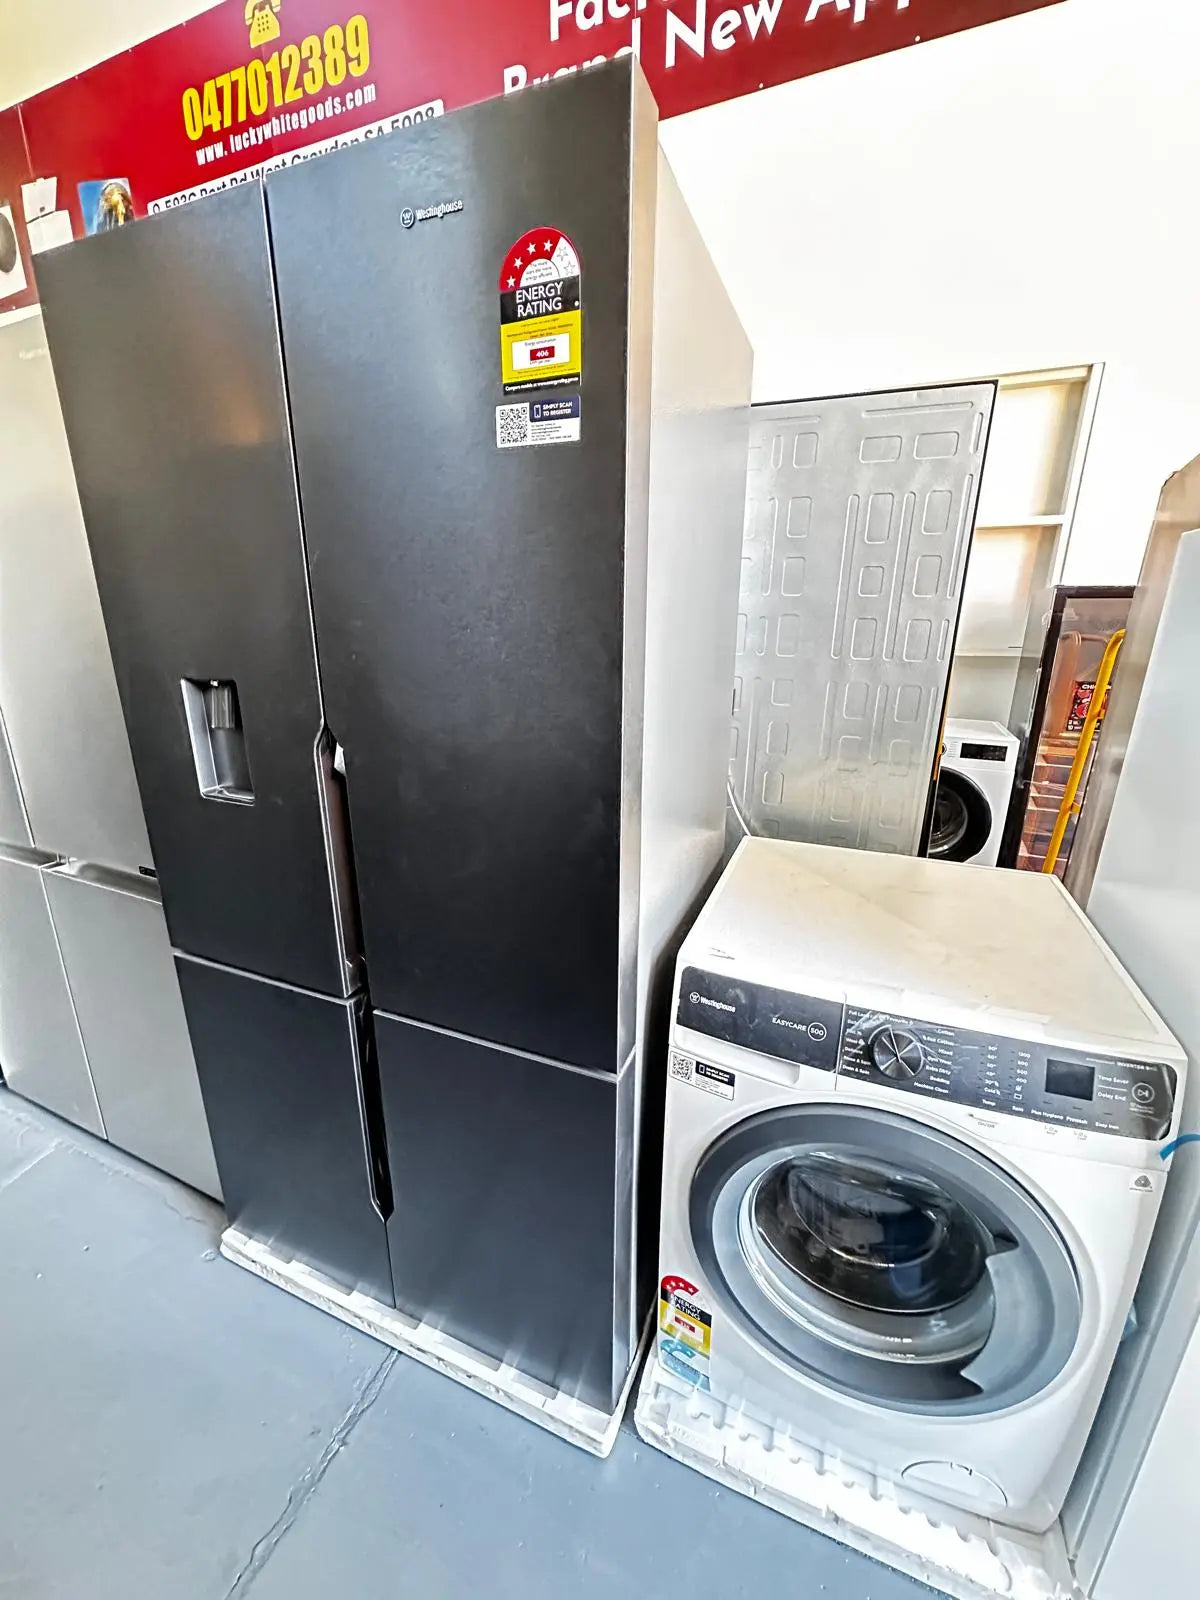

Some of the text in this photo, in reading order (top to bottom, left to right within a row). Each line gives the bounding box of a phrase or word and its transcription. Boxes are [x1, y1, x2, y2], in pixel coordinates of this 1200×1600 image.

[182, 14, 370, 141] 0477012389
[229, 83, 377, 153] luckywhitegoods.com
[416, 200, 463, 220] Westinghouse
[515, 280, 564, 305] ENERGY
[517, 297, 562, 319] RATING
[701, 996, 736, 1013] Westinghouse
[772, 1017, 824, 1037] EASYCARE 500
